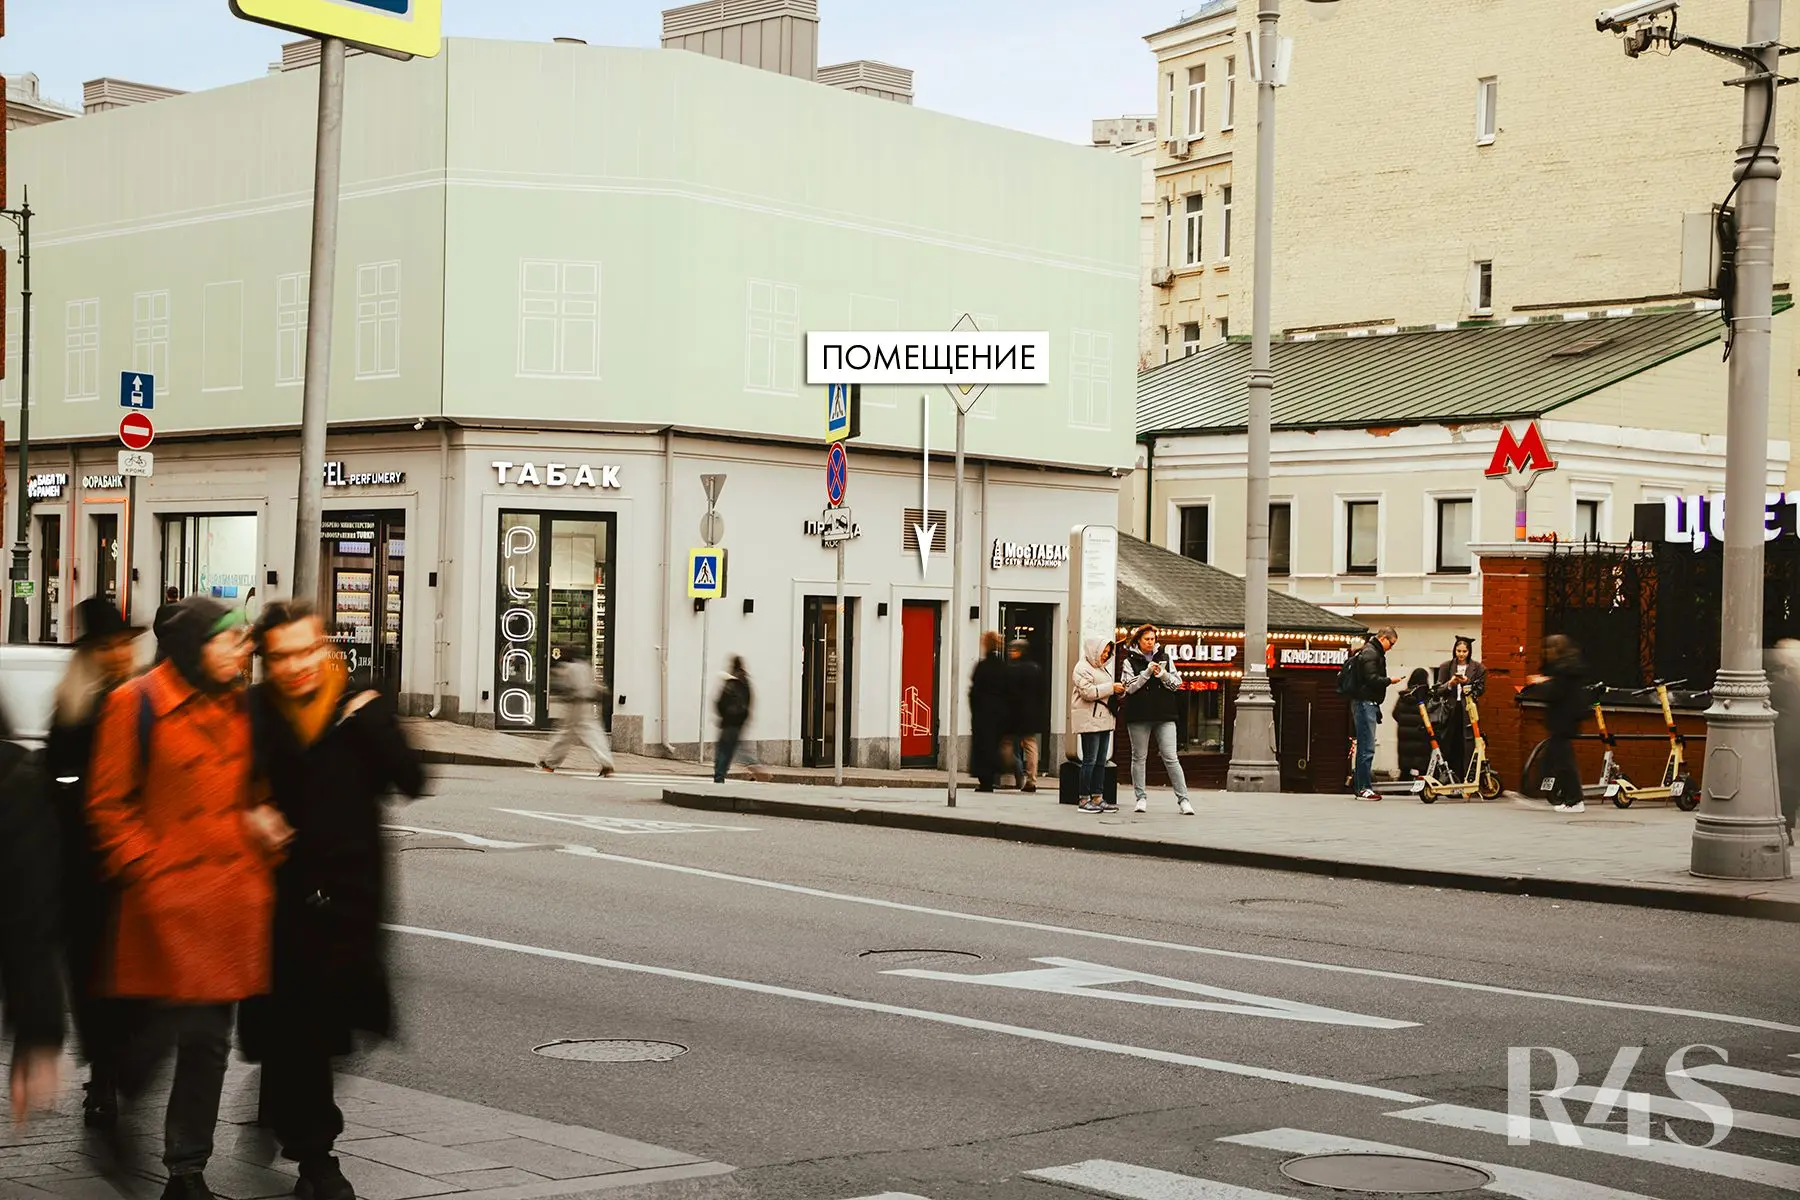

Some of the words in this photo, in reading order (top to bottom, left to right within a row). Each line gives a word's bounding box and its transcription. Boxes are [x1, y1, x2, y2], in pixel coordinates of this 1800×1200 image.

[82, 475, 123, 489] ФОРАБАНК
[349, 471, 402, 486] PERFUMERY
[491, 460, 622, 489] ТАБАК
[347, 648, 358, 673] 3
[1165, 644, 1238, 662] ДОНЕР
[1280, 647, 1349, 664] КАФЕТЕРИЙ
